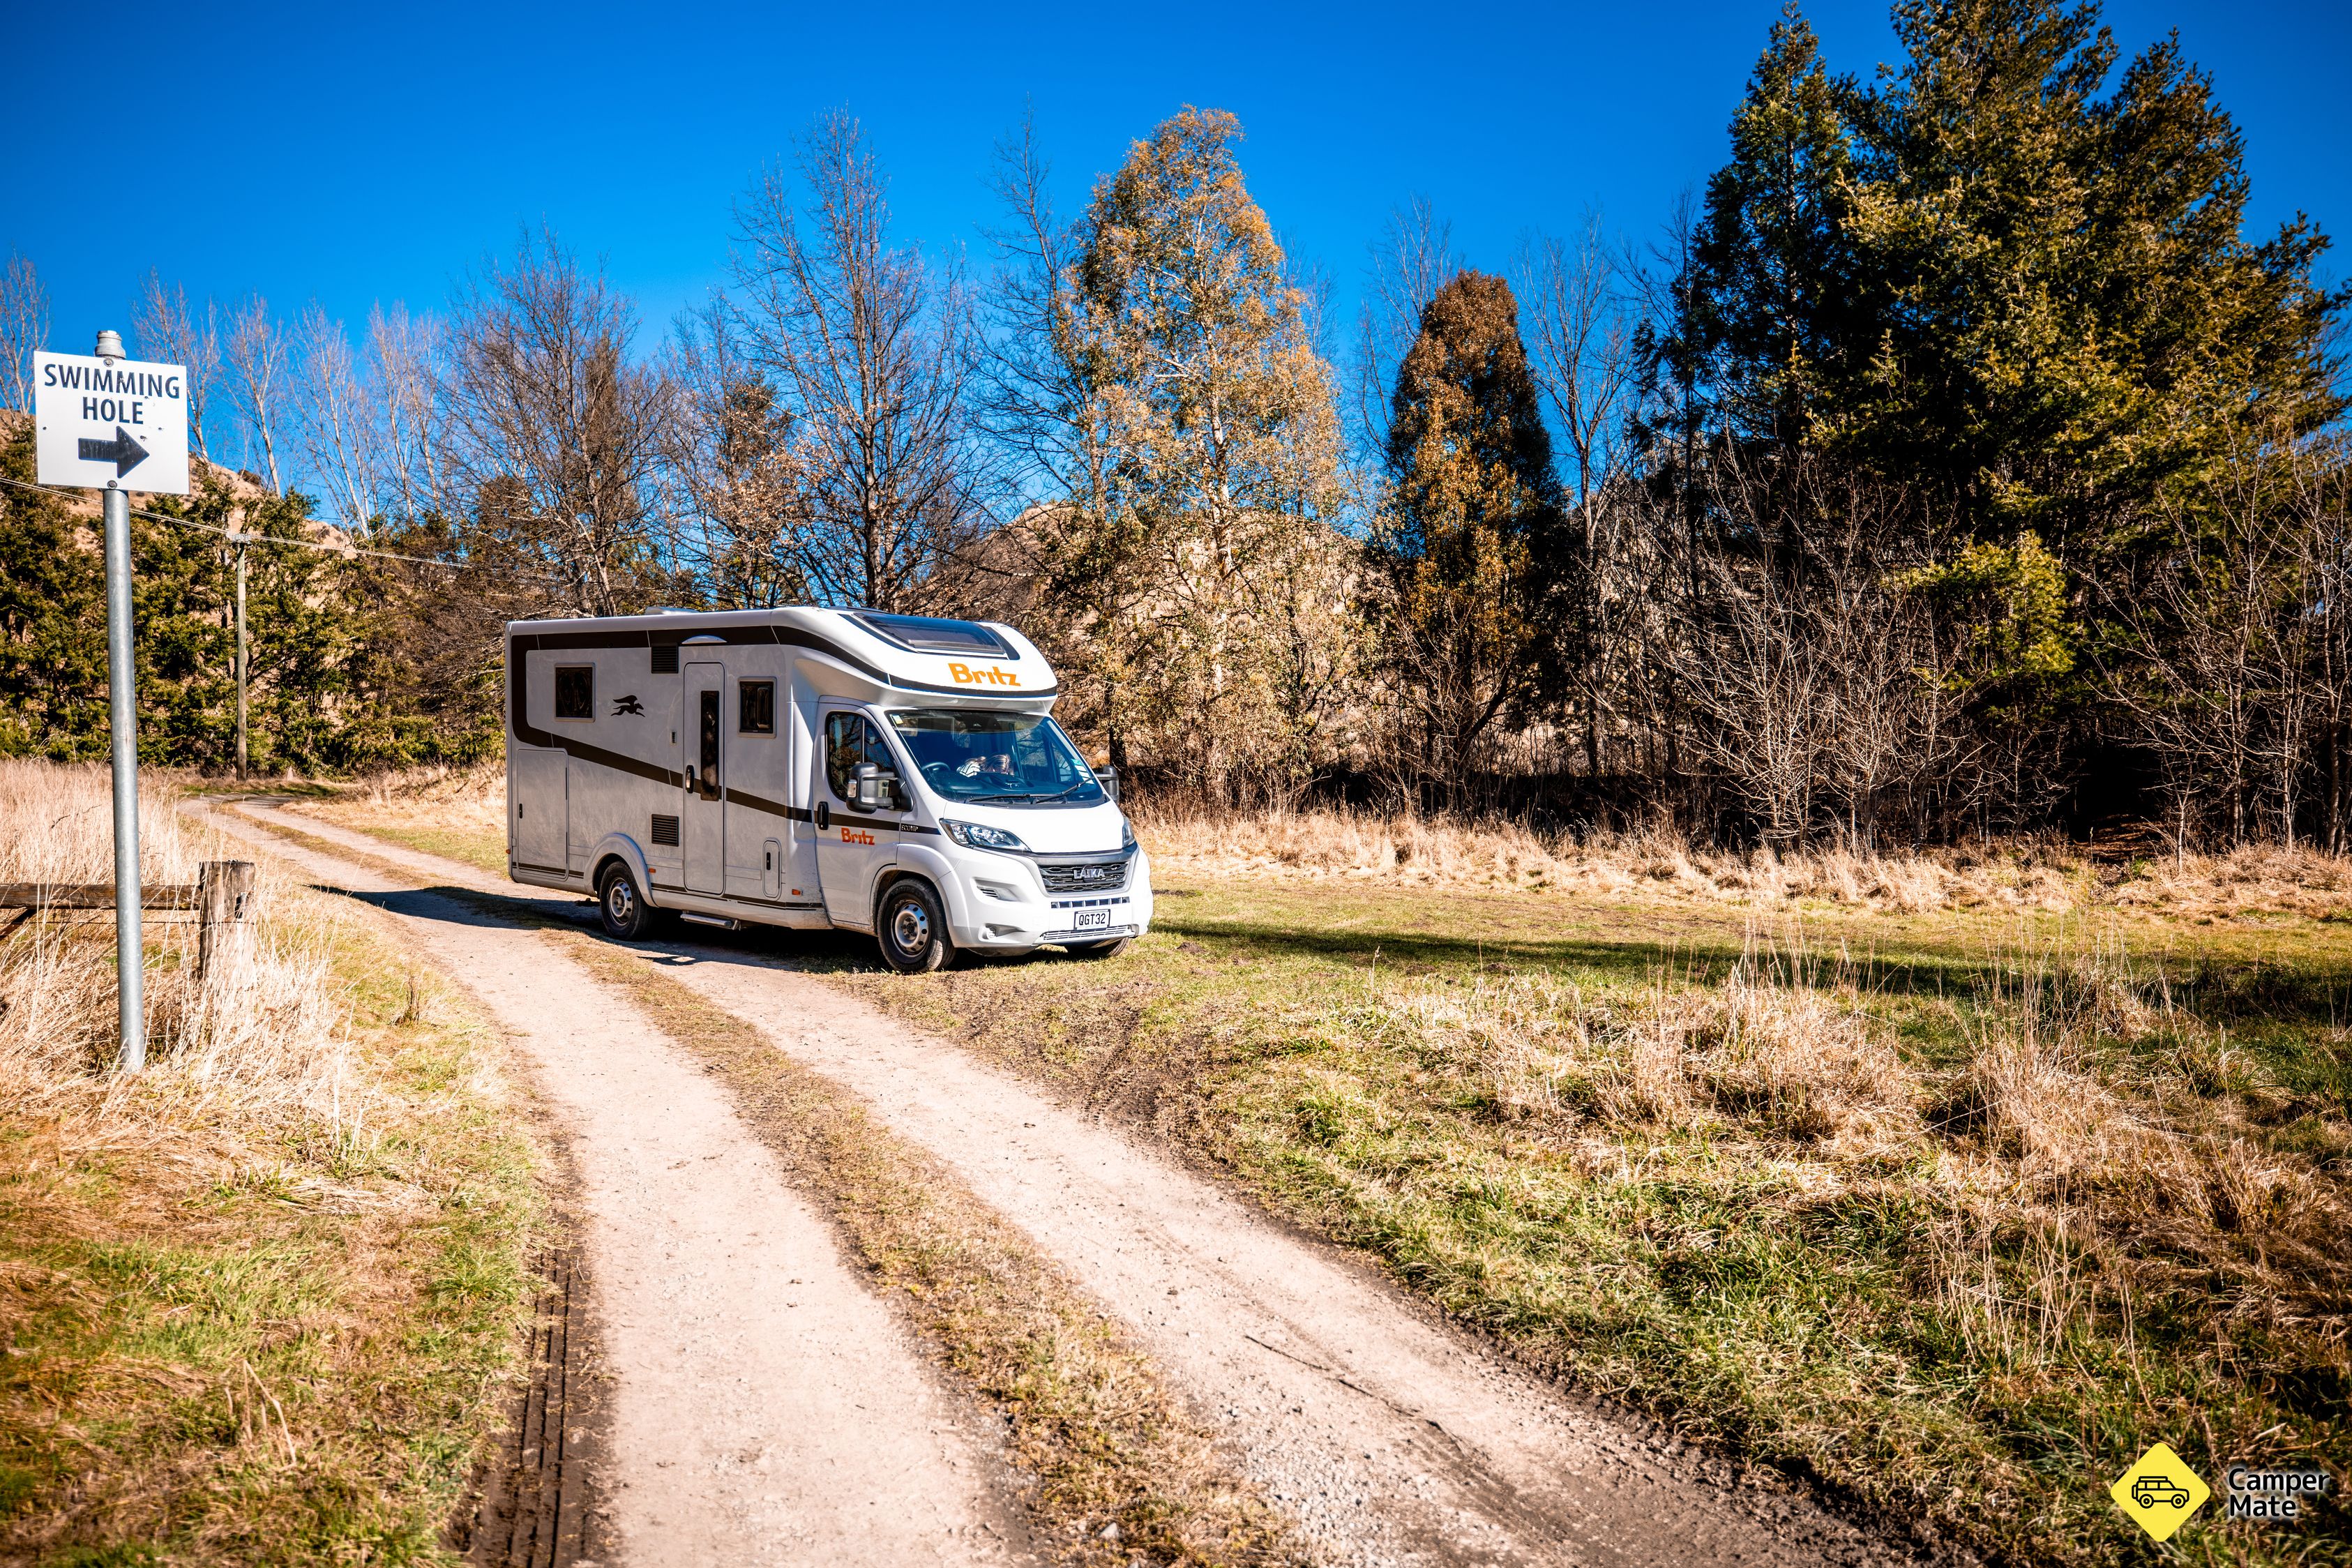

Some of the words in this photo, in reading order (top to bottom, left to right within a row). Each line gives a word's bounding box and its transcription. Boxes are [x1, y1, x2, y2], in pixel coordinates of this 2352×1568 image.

[44, 363, 179, 399] SWIMMING
[82, 396, 144, 424] HOLE
[948, 663, 1021, 686] Britz
[840, 827, 875, 845] Britz
[1073, 868, 1106, 879] LAIKA
[1078, 913, 1106, 926] QGT32
